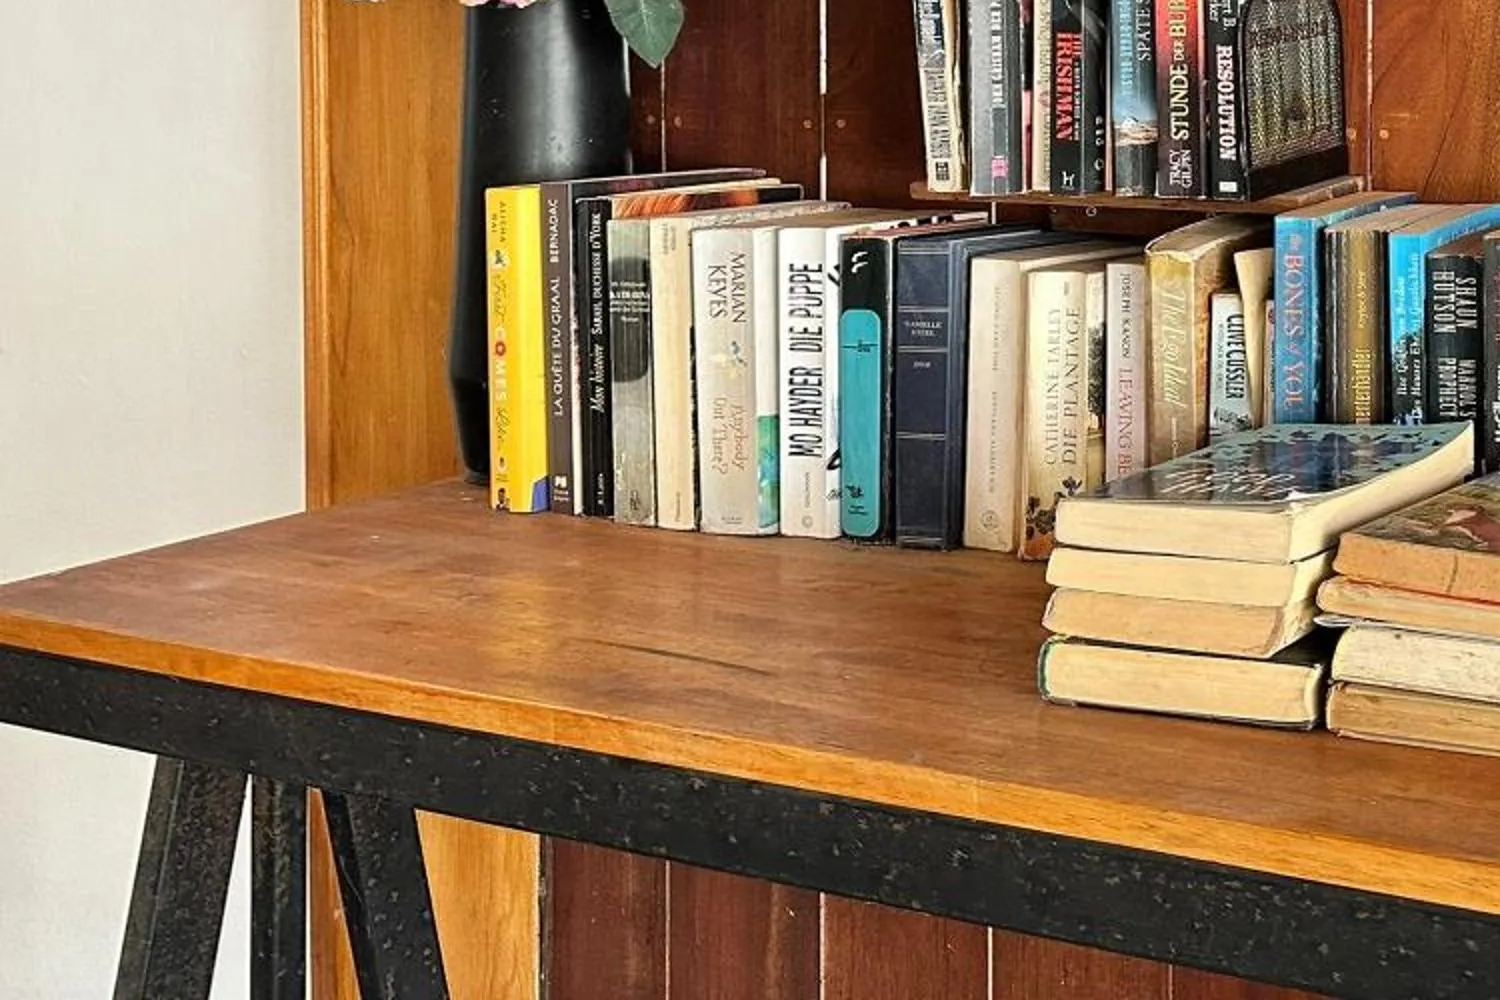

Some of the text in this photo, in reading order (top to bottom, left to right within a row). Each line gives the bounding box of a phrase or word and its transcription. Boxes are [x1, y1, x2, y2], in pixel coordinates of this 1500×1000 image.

[988, 10, 1002, 32] DER
[1227, 16, 1238, 33] B.
[989, 34, 1005, 82] GRISHAM
[1054, 31, 1074, 142] IRISHMAN
[1169, 38, 1191, 141] STUNDE DER
[1215, 44, 1237, 162] RESOLUTION
[1170, 149, 1183, 186] TRACY
[1181, 149, 1193, 189] GILPIN
[590, 252, 603, 299] DUCHESSE
[706, 263, 728, 320] KEYES
[728, 250, 747, 325] MARIAN
[1165, 285, 1190, 325] The
[1284, 254, 1305, 338] BONES
[1433, 270, 1456, 334] HUTSON
[1456, 276, 1479, 330] SHAUN
[548, 199, 564, 417] LA QUÊTE DU GRAAL BERNADAC
[590, 342, 607, 384] histoire
[787, 262, 823, 459] MO HAYDER DIE PUPPE
[1062, 305, 1082, 466] DIE PLANTAGE
[1118, 272, 1134, 449] JOSEPH KANON LEAVING
[1224, 312, 1248, 399] CLIVE CUSSLER
[1436, 356, 1458, 418] PROPHECY
[590, 386, 606, 413] Mon
[1044, 372, 1062, 467] CATHERINE
[1457, 358, 1477, 419] WARHOL'S
[710, 397, 729, 477] Out There?
[731, 403, 751, 472] Anybody
